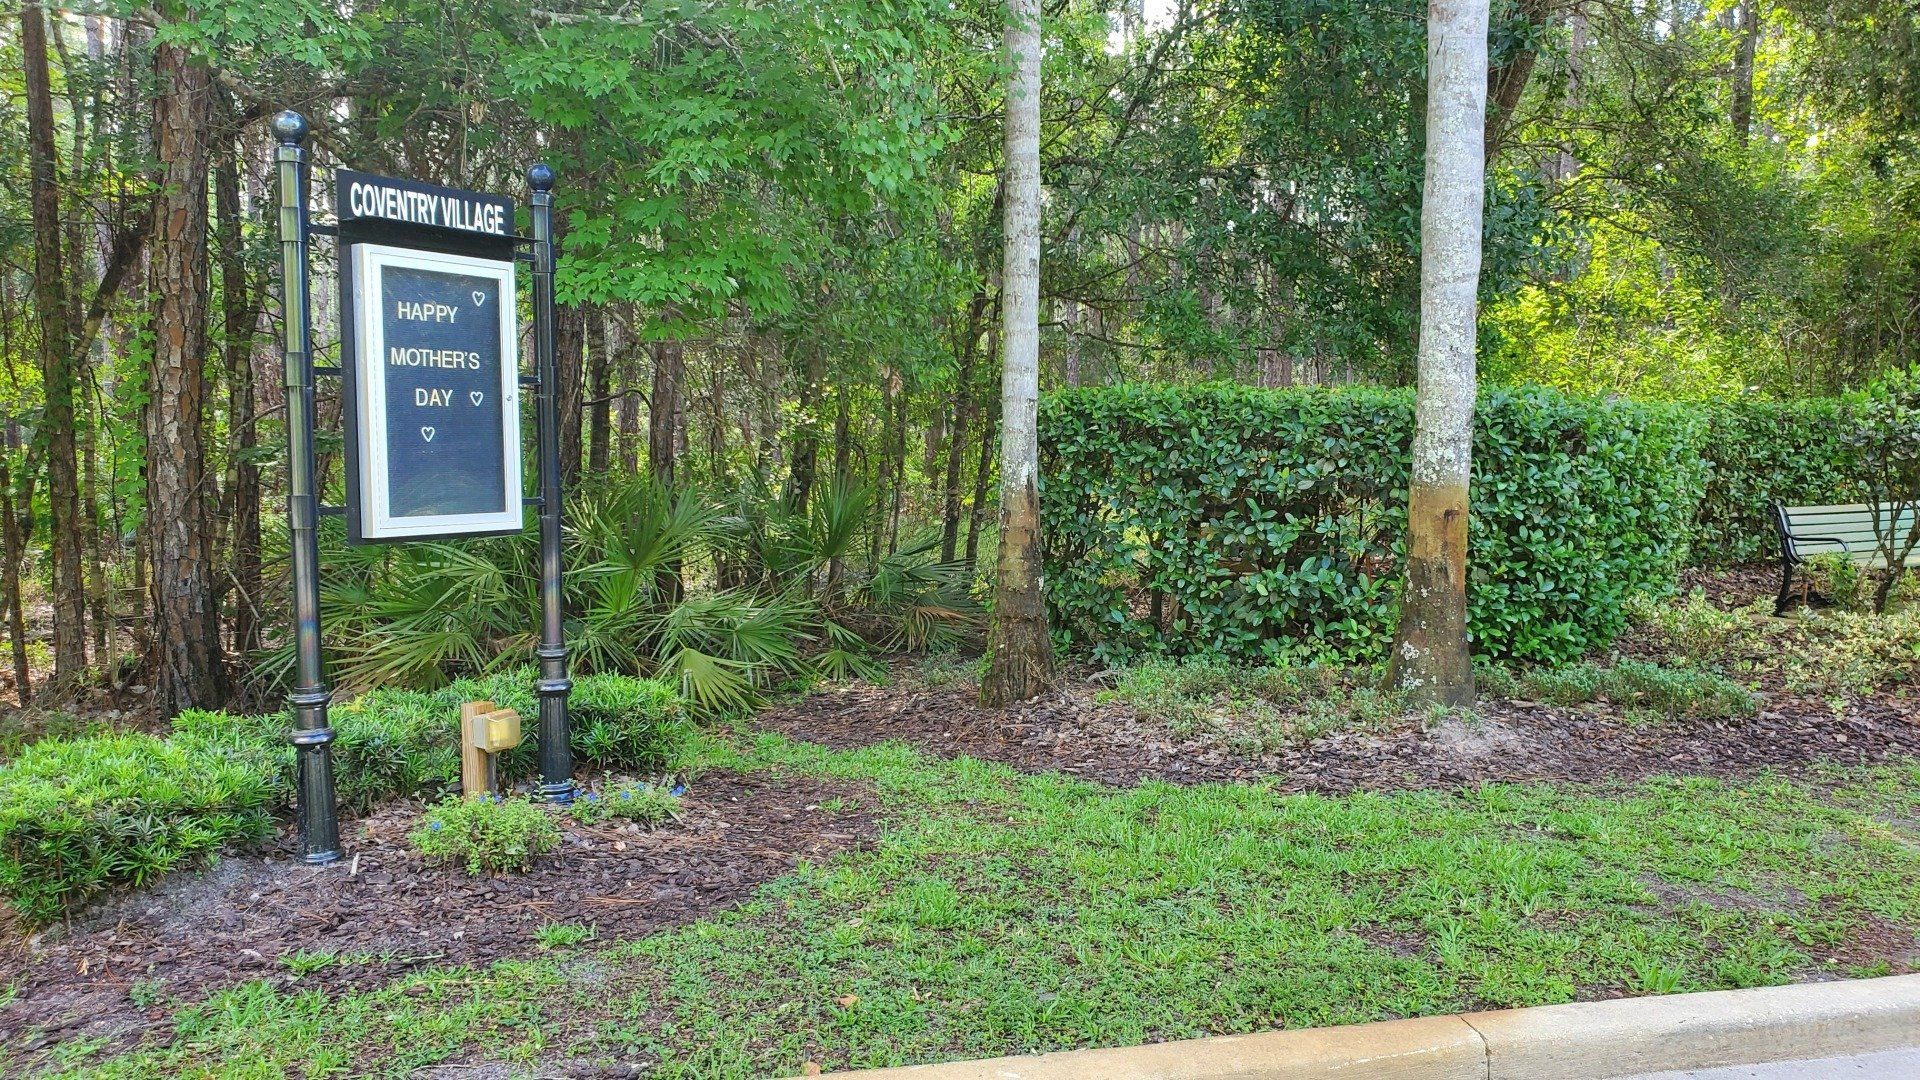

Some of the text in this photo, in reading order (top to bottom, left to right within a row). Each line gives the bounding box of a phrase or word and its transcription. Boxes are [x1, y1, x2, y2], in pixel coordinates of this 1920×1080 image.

[350, 182, 505, 235] COVENTRY VILLAGE
[397, 301, 458, 324] HAPPY
[390, 347, 480, 370] MOTHER'S
[415, 388, 453, 407] DAY
